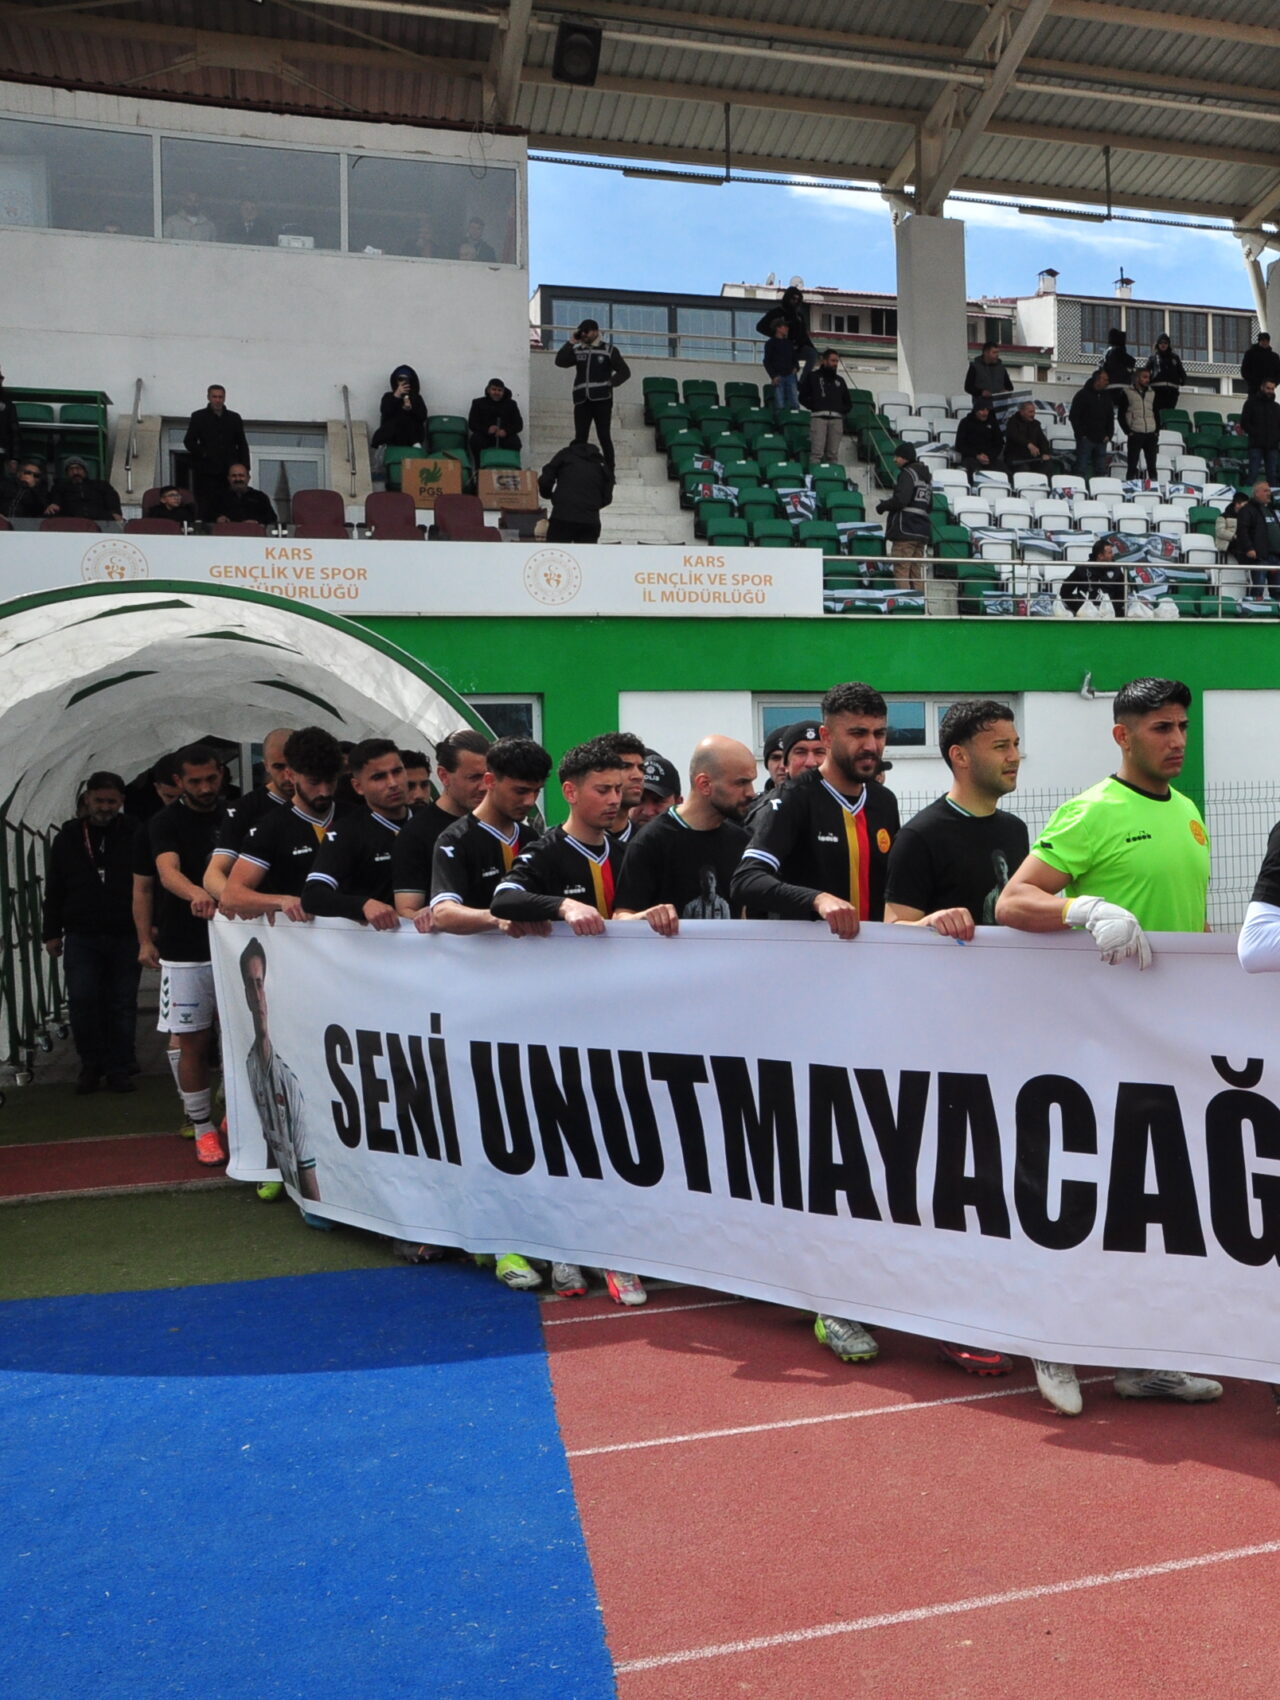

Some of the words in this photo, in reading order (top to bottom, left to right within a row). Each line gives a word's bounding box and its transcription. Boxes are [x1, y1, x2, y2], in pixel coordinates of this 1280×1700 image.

[418, 487, 444, 497] PGS
[264, 547, 313, 560] KARS
[683, 555, 725, 568] KARS
[208, 563, 288, 582] GENÇLİK
[293, 567, 315, 580] VE
[320, 567, 368, 581] SPOR
[634, 570, 703, 588] GENÇLİK
[707, 573, 727, 586] VE
[732, 573, 773, 586] SPOR
[241, 582, 360, 600] ÜDÜRLÜĞÜ
[642, 588, 656, 602] İL
[660, 588, 767, 604] MÜDÜRLÜĞÜ
[323, 1011, 463, 1167] SENİ
